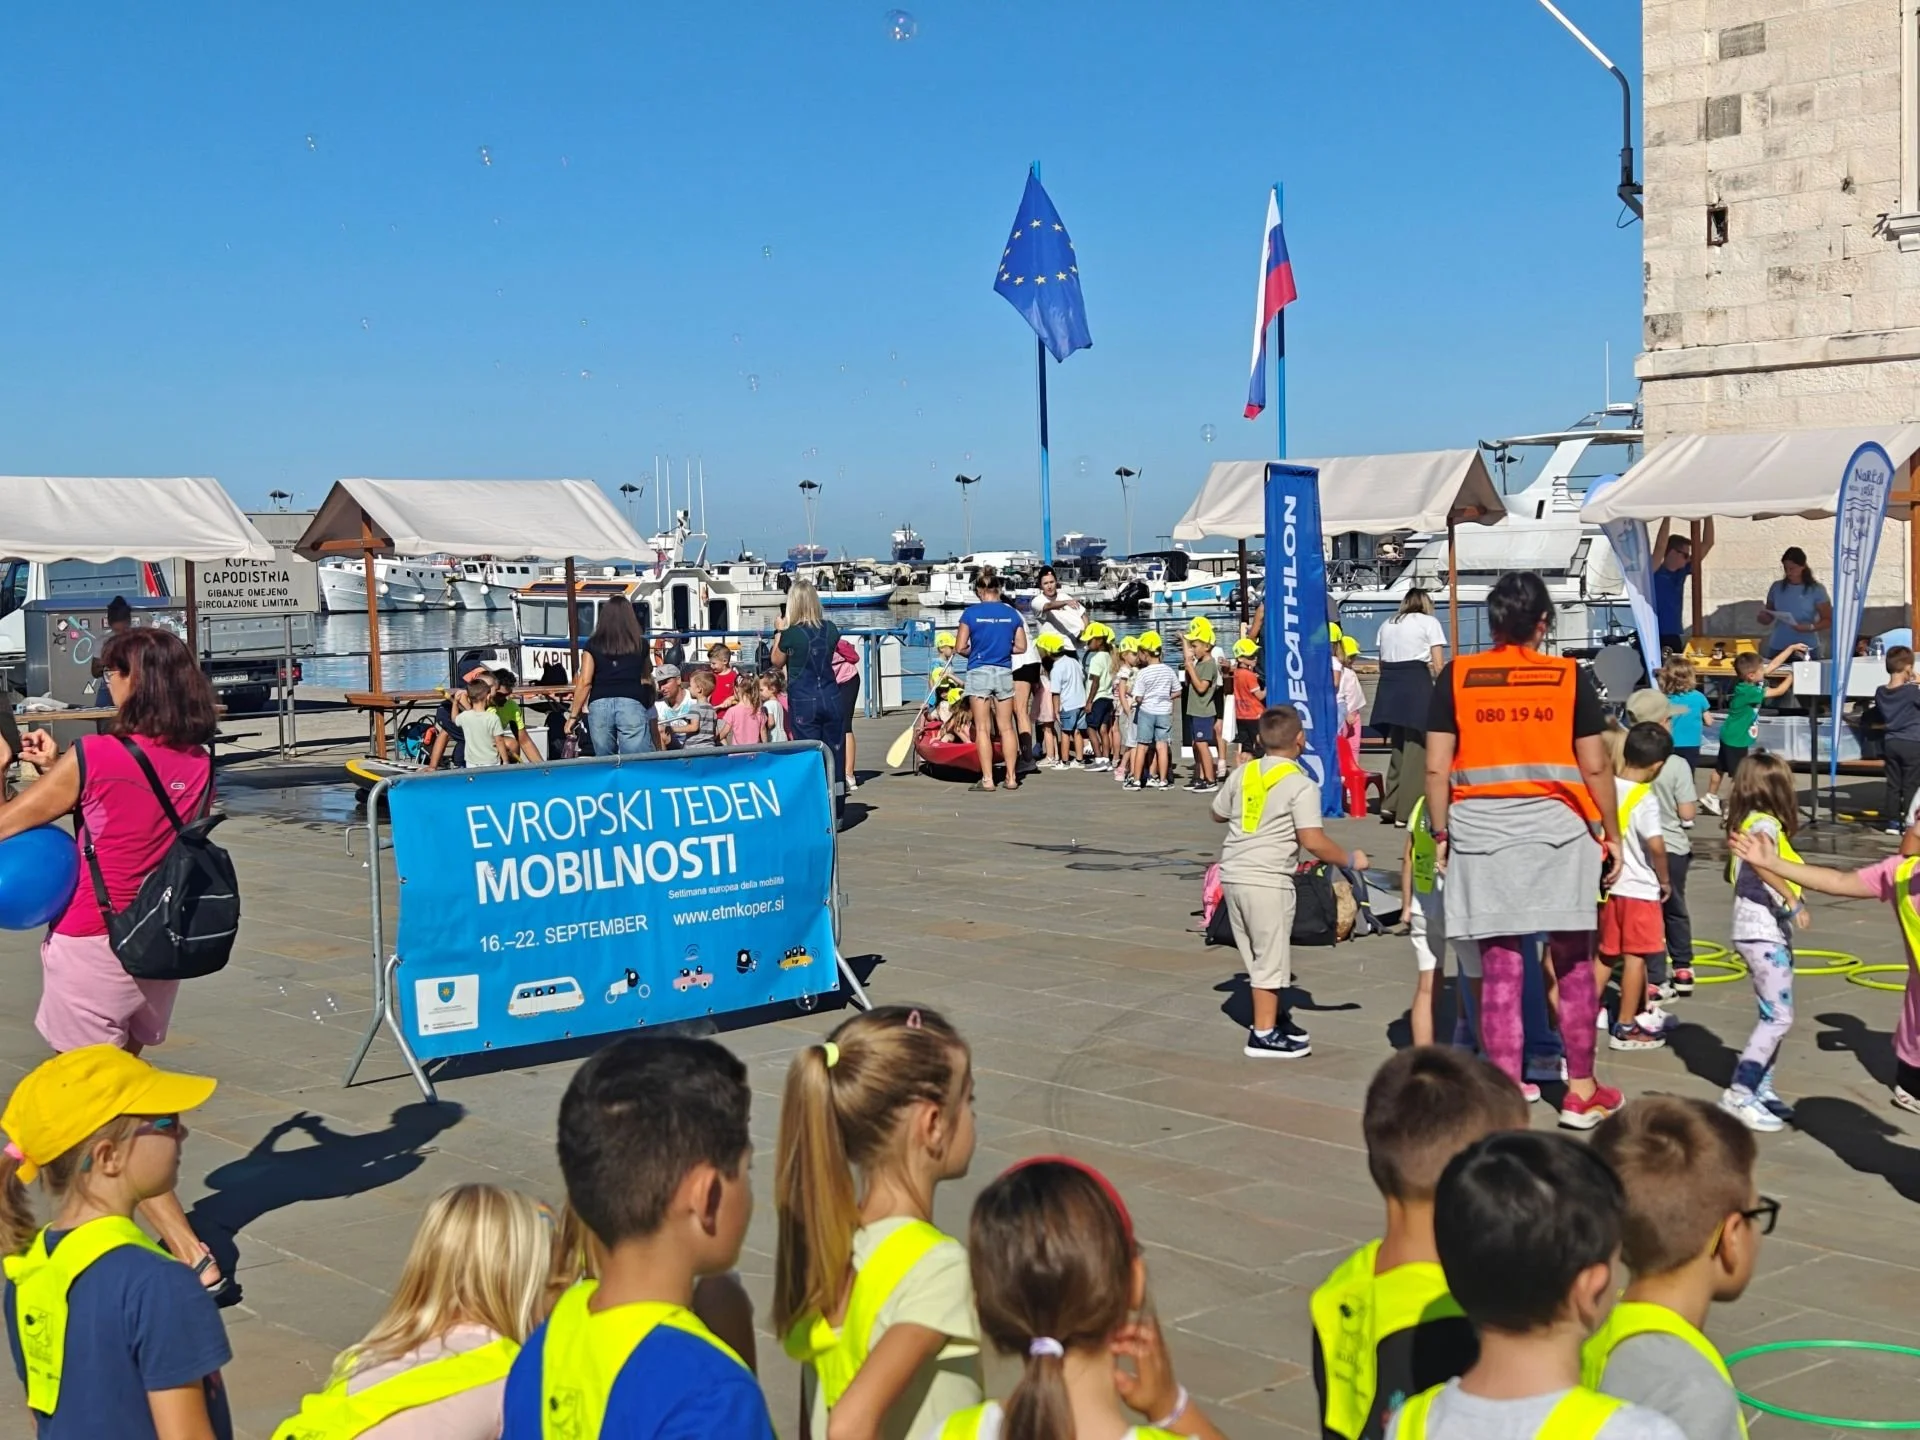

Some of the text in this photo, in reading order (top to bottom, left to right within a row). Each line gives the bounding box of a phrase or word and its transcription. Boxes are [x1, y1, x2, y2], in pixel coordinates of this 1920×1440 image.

[203, 570, 290, 583] CAPODISTRIA
[207, 588, 288, 597] GIBANJE OMEJENO
[262, 598, 299, 608] LIMITATA
[1283, 495, 1313, 729] DECATHLON
[533, 650, 583, 671] KAPIT
[1475, 707, 1554, 723] 080 19 40
[466, 779, 781, 849] EVROPSKI TEDEN
[475, 834, 737, 905] MOBILNOSTI
[668, 887, 708, 899] Settimana
[708, 884, 739, 894] europea
[740, 880, 758, 890] della
[673, 895, 785, 926] www.etmkoper.si
[545, 914, 649, 945] SEPTEMBER
